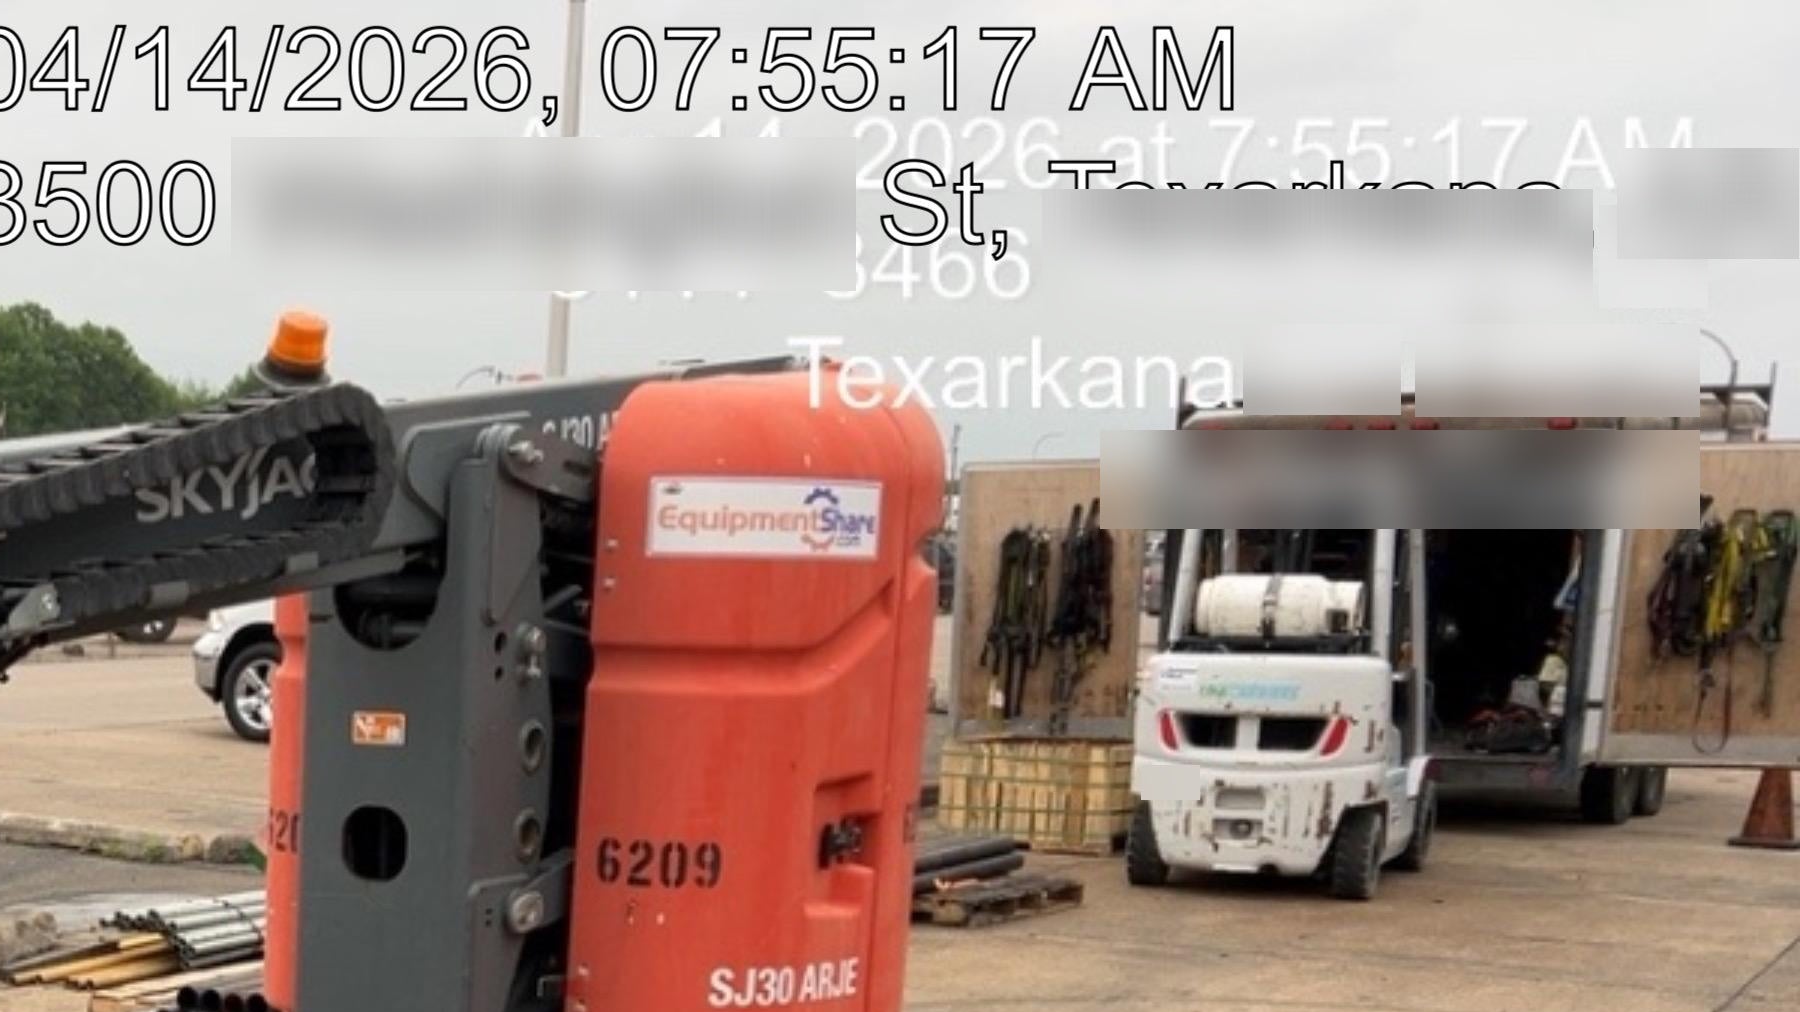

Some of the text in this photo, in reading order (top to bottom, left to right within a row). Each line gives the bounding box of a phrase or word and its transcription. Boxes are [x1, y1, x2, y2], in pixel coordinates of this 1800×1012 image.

[596, 837, 721, 889] 6209
[707, 956, 859, 1008] SJ30 ARJE
